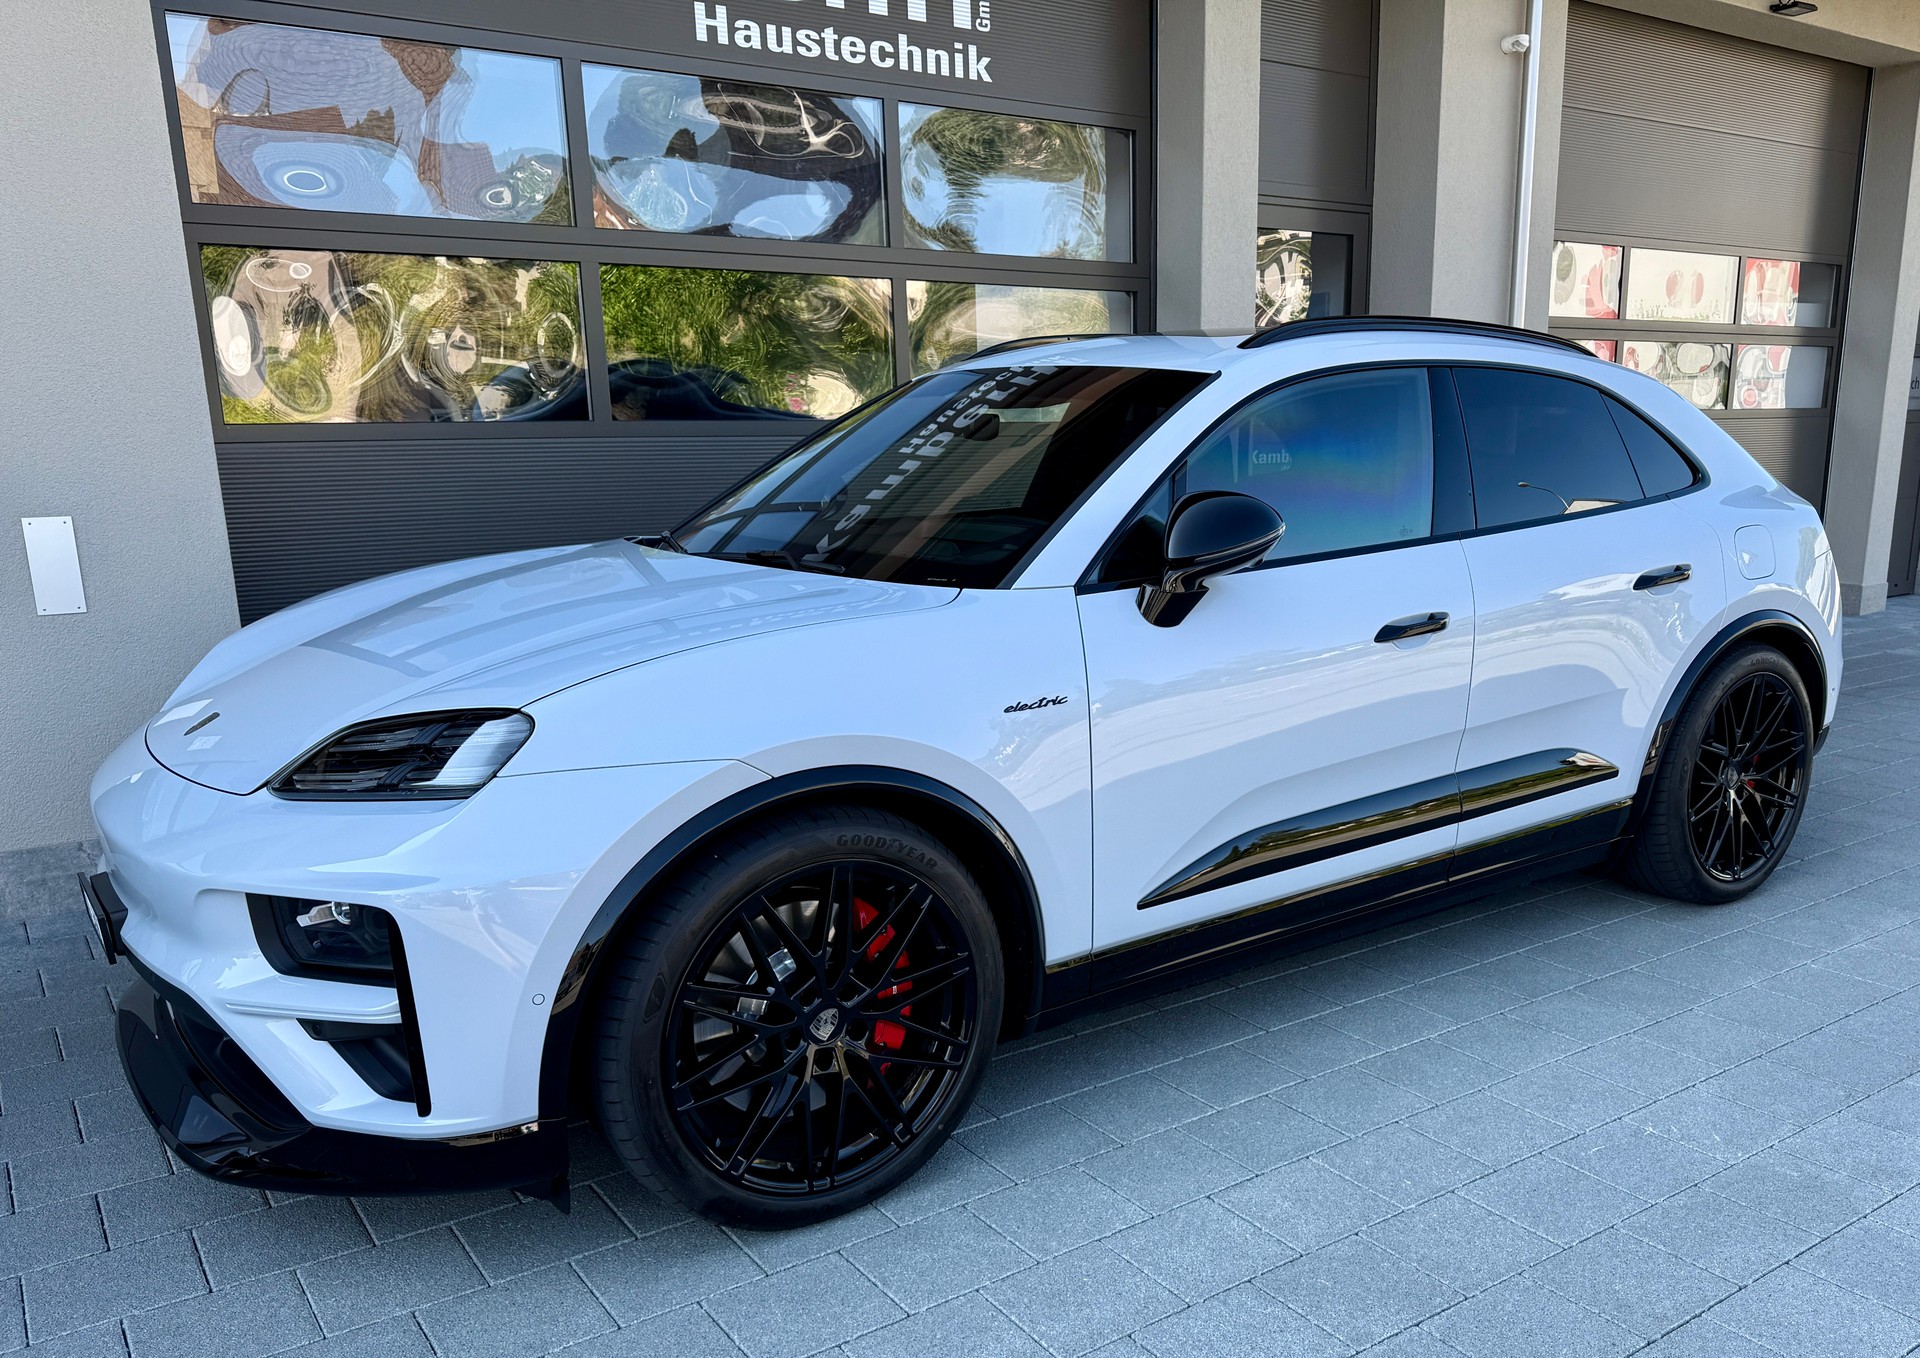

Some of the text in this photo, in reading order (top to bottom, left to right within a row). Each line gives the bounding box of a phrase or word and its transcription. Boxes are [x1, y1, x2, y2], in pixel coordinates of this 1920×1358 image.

[693, 1, 993, 83] Haustechnik
[1003, 696, 1068, 713] electric
[837, 834, 938, 870] GOODYEAR
